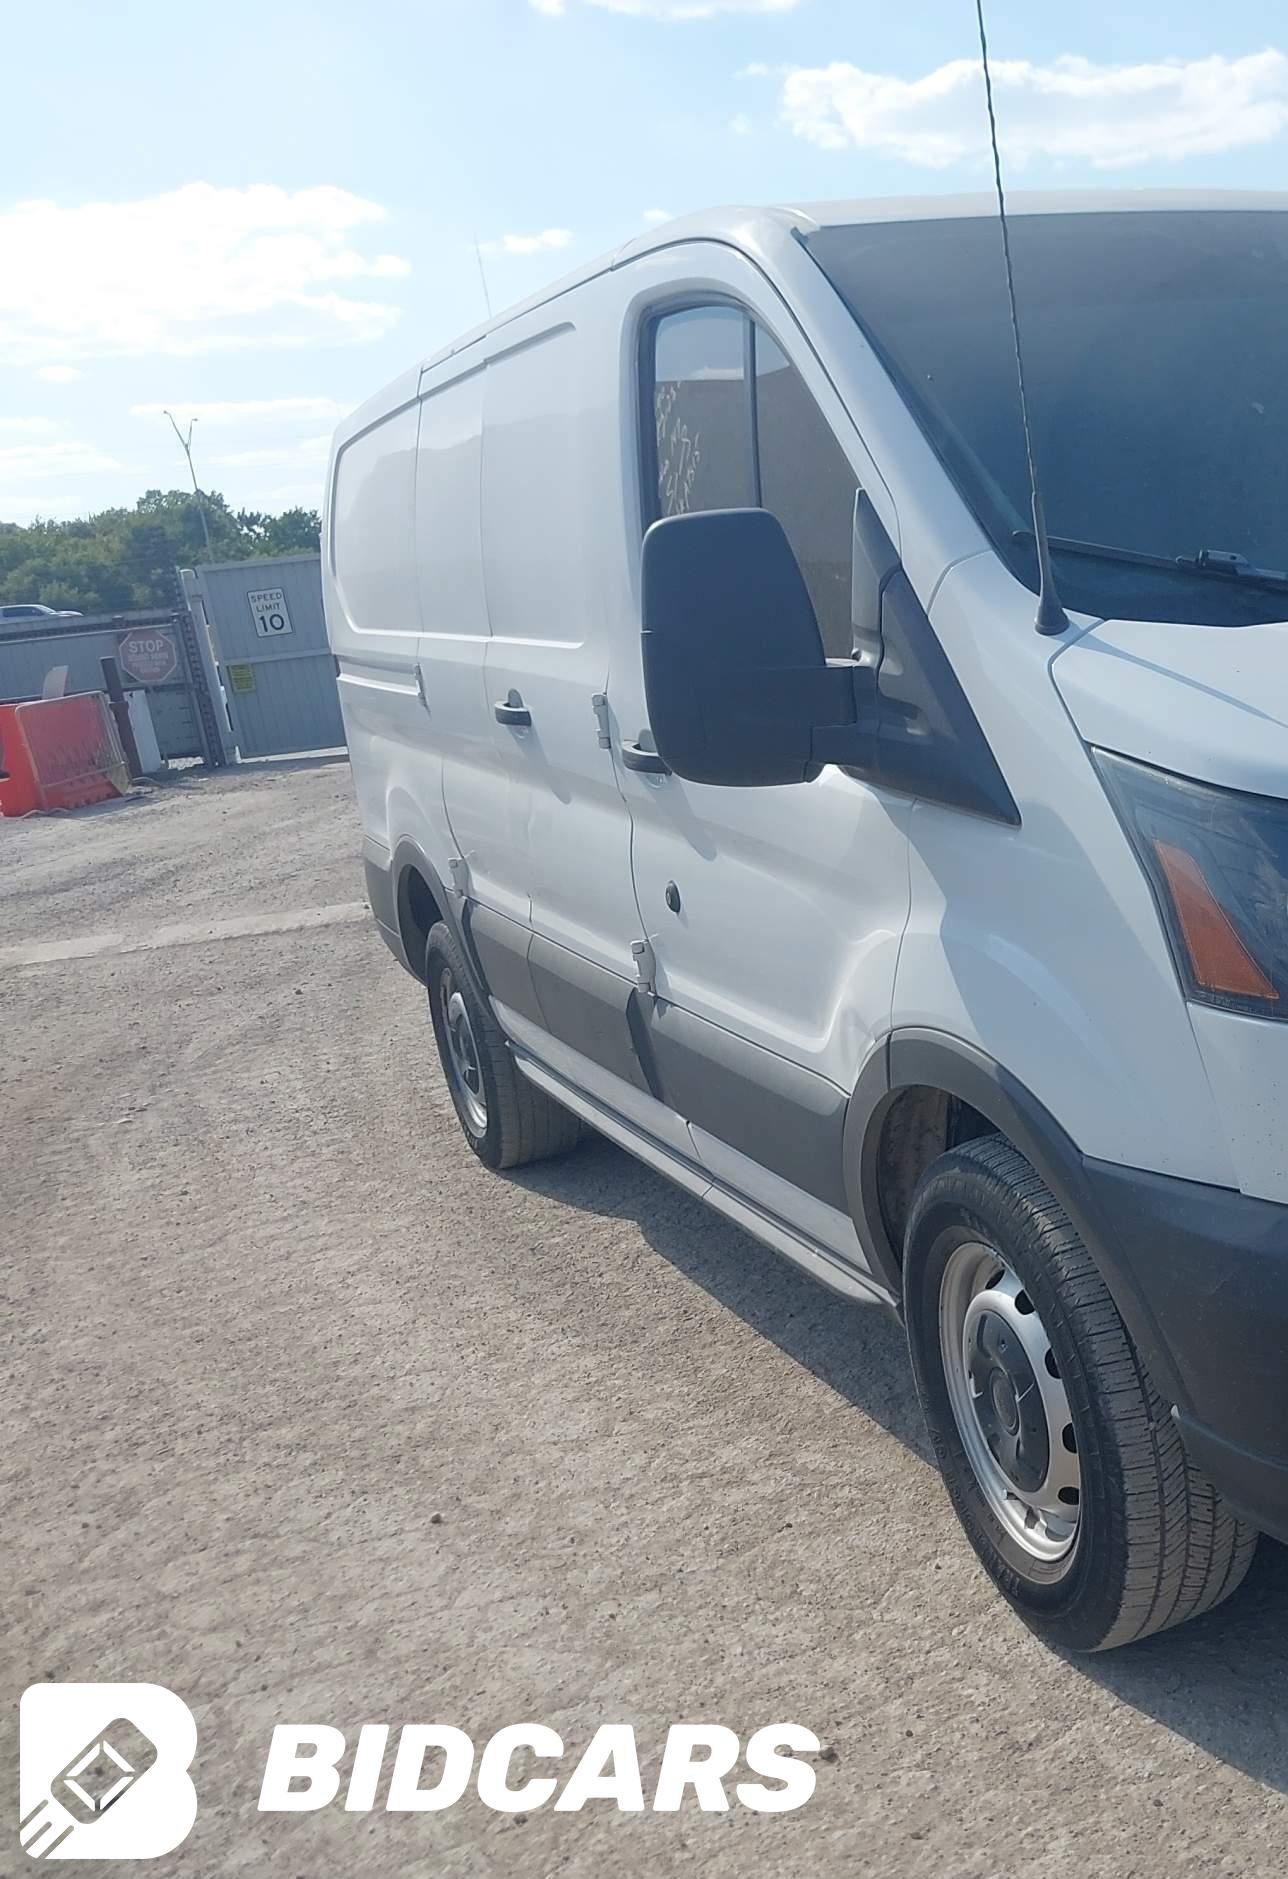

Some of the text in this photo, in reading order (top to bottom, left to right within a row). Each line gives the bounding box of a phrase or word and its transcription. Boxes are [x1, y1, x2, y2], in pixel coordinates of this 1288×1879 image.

[250, 592, 282, 603] SPEED
[256, 602, 281, 612] LIMIT
[260, 613, 285, 632] 10
[129, 639, 164, 653] STOP
